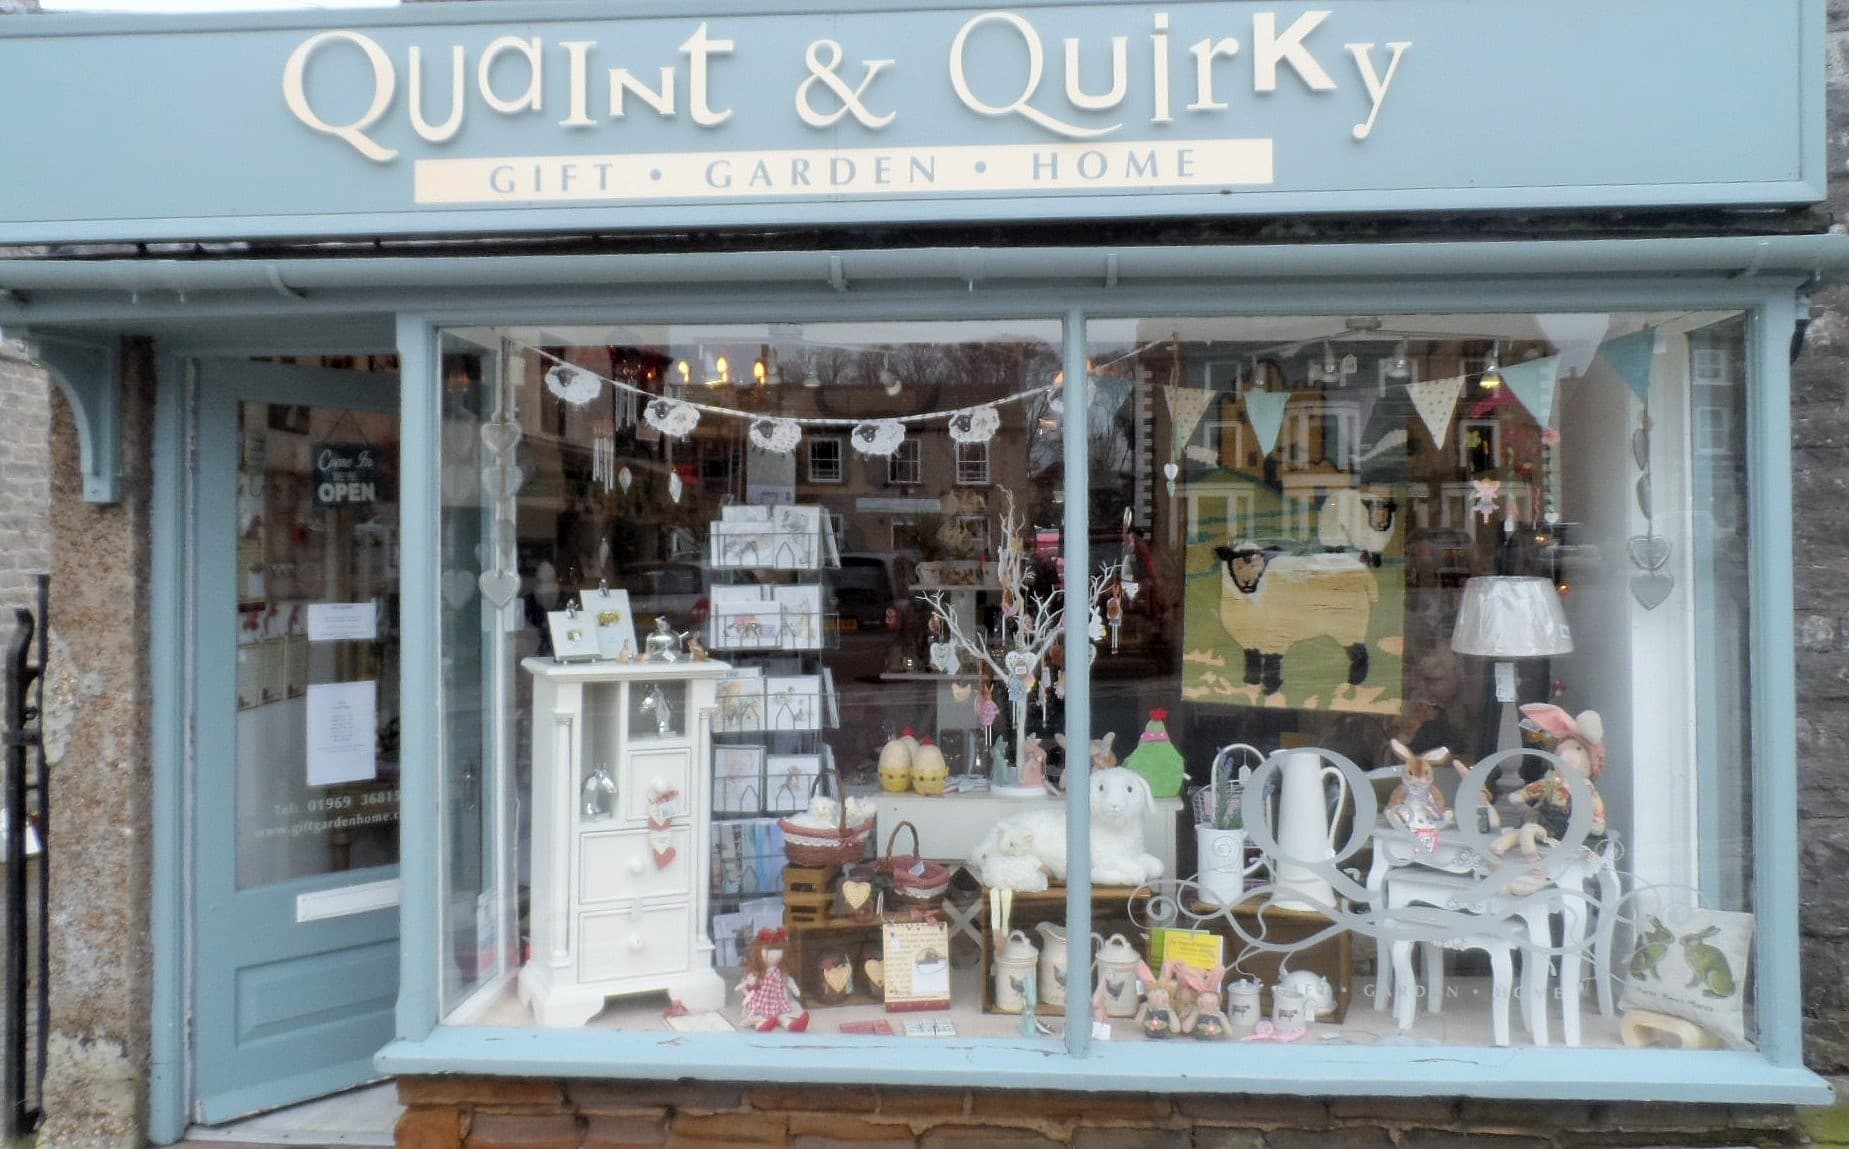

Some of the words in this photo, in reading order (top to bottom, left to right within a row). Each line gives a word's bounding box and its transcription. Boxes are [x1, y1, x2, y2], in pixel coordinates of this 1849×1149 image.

[795, 39, 897, 131] &
[489, 162, 613, 193] GIFT
[705, 154, 935, 189] GARDEN
[1032, 149, 1195, 181] HOME
[317, 449, 351, 471] Come
[318, 482, 376, 502] OPEN
[308, 794, 351, 812] 01969
